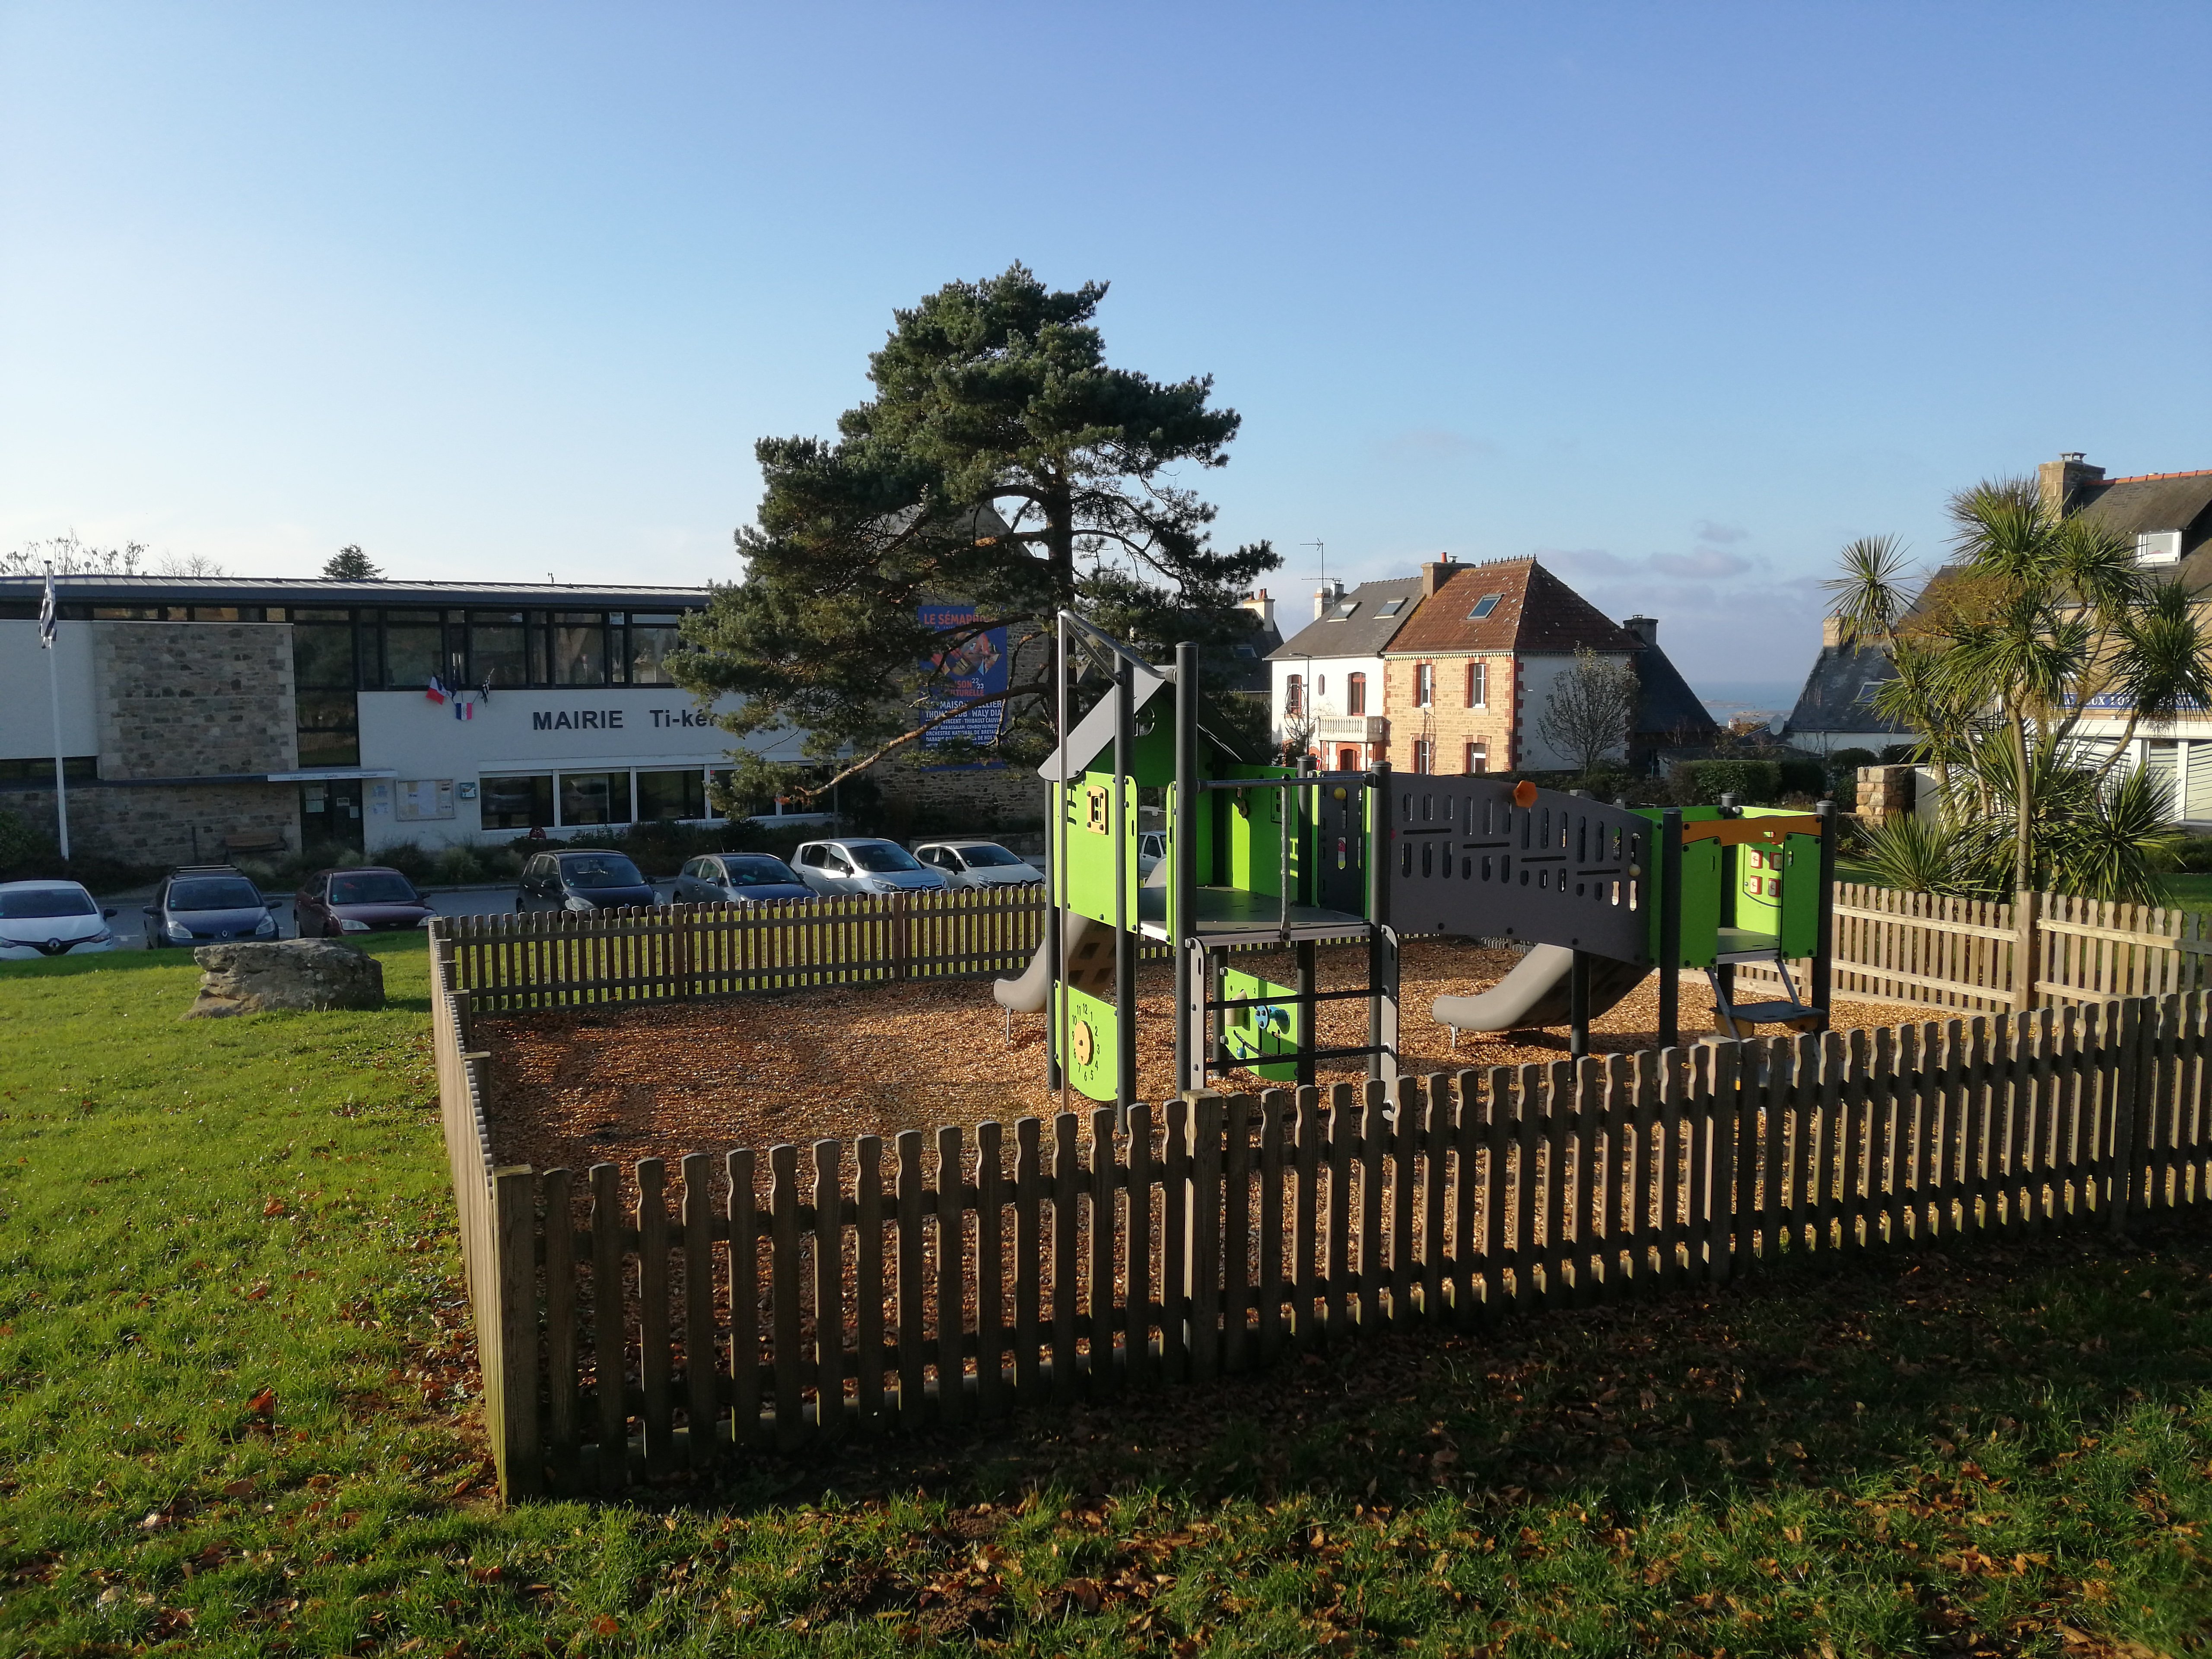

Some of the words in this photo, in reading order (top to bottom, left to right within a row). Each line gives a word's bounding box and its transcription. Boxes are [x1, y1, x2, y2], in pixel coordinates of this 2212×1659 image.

[924, 613, 935, 625] LE
[972, 709, 988, 718] WALY
[533, 710, 623, 730] MAIRIE
[1077, 1004, 1081, 1016] 11
[1083, 1003, 1088, 1015] 12
[1072, 1014, 1077, 1026] 10
[1090, 1011, 1093, 1021] 1
[1072, 1030, 1074, 1041] 9
[1095, 1026, 1098, 1037] 2
[1074, 1048, 1076, 1059] 8
[1096, 1044, 1100, 1055] 3
[1078, 1062, 1081, 1073] 7
[1095, 1060, 1098, 1071] 4
[1084, 1071, 1087, 1082] 6
[1090, 1069, 1093, 1081] 5
